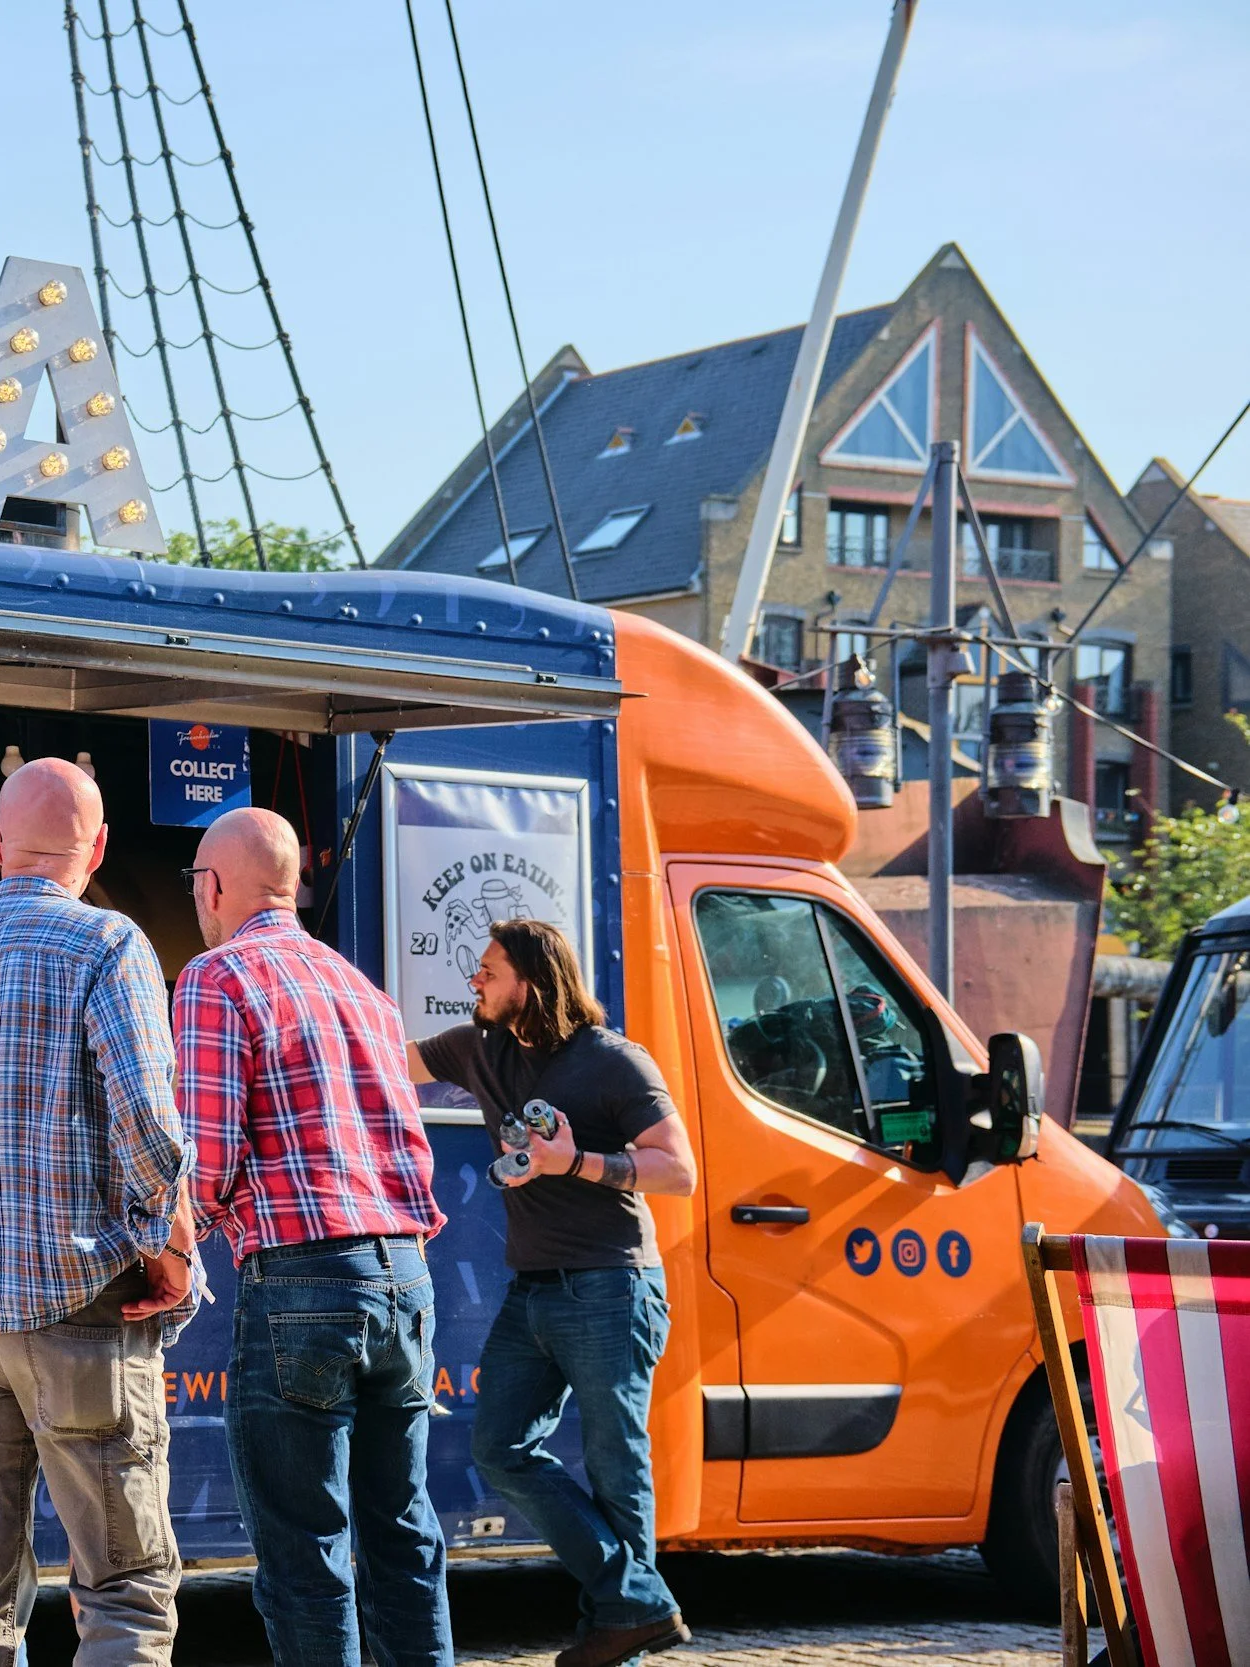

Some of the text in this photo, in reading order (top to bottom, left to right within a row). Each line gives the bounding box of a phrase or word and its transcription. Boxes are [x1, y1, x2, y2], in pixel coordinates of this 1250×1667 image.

[170, 759, 237, 781] COLLECT
[185, 784, 223, 803] HERE
[422, 861, 465, 912] KEEP
[470, 852, 498, 874] ON
[410, 932, 439, 955] 20
